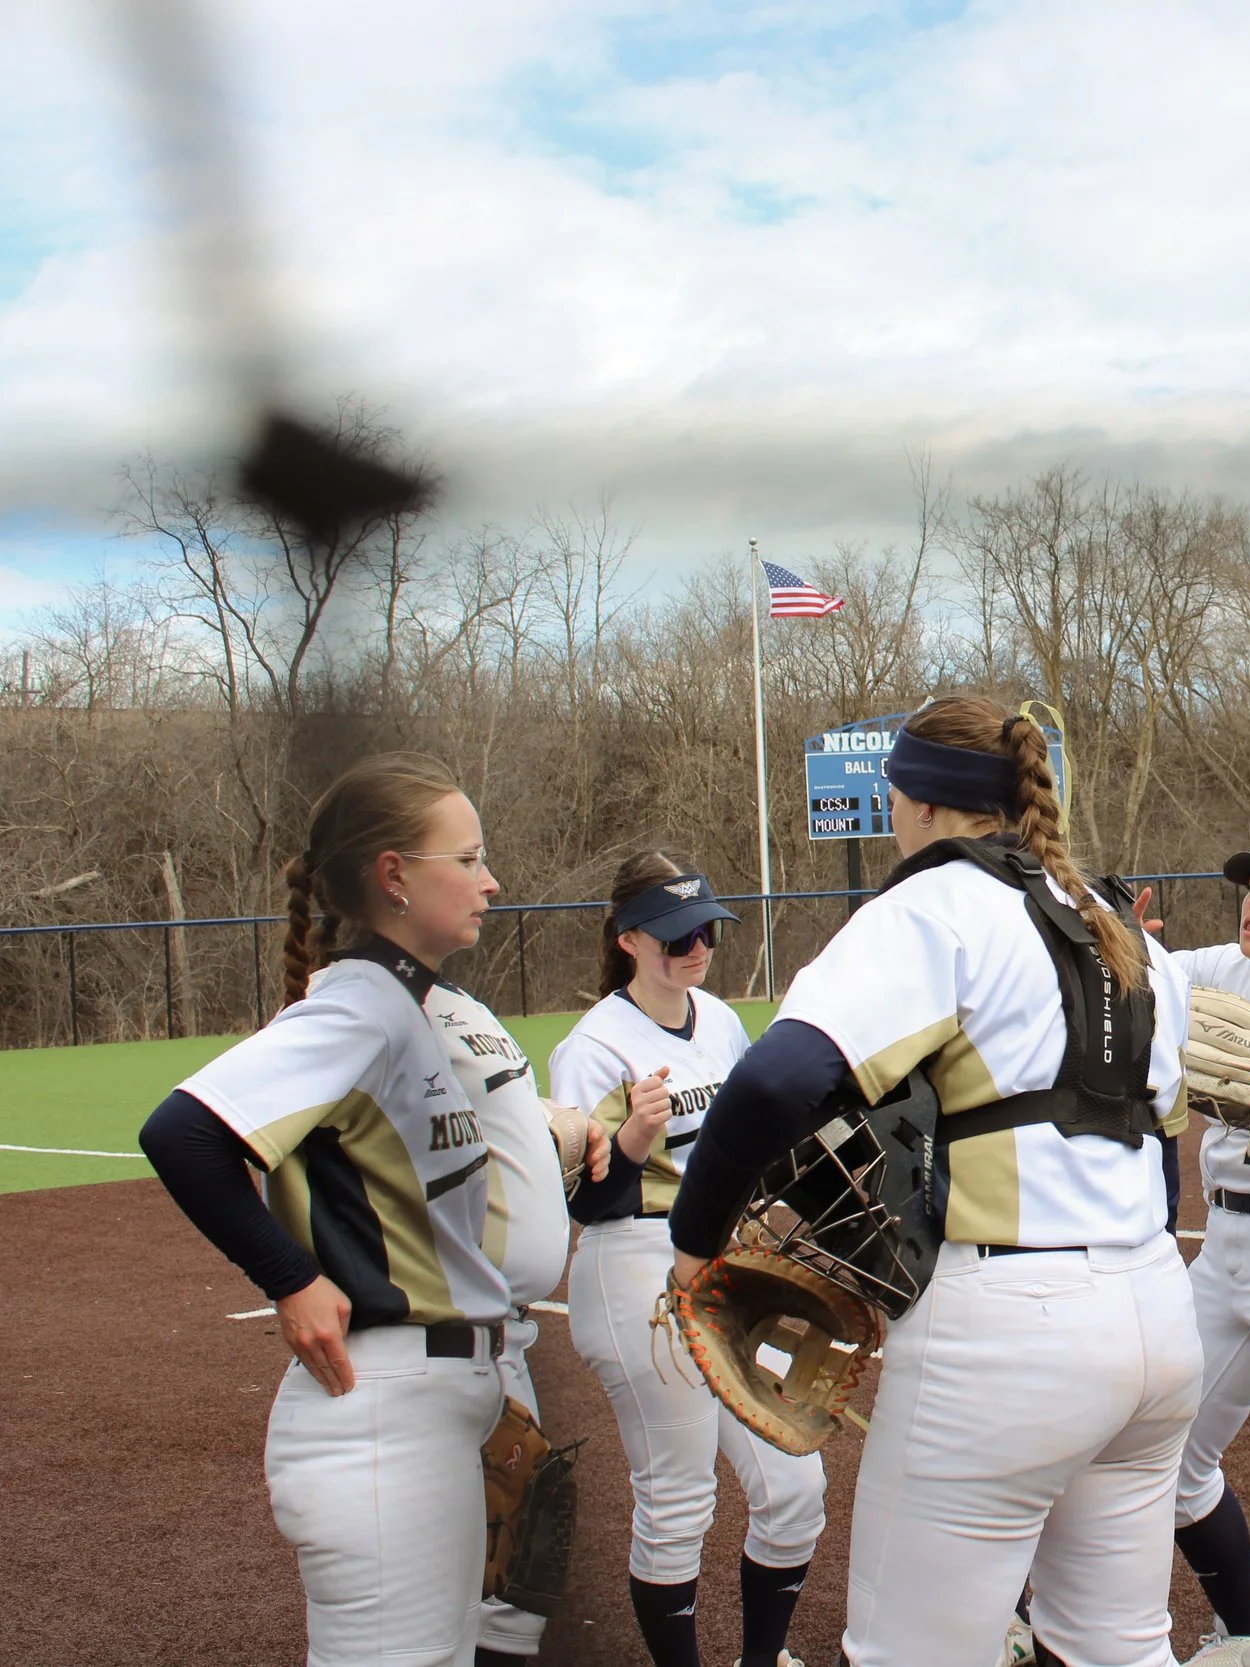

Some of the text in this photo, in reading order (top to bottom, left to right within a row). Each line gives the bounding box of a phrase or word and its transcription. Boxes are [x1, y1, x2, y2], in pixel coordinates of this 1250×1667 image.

[823, 731, 899, 752] NICOL
[845, 761, 875, 774] BALL
[873, 782, 878, 793] 1
[820, 794, 881, 811] CCSJ 7
[815, 818, 854, 833] MOUNT
